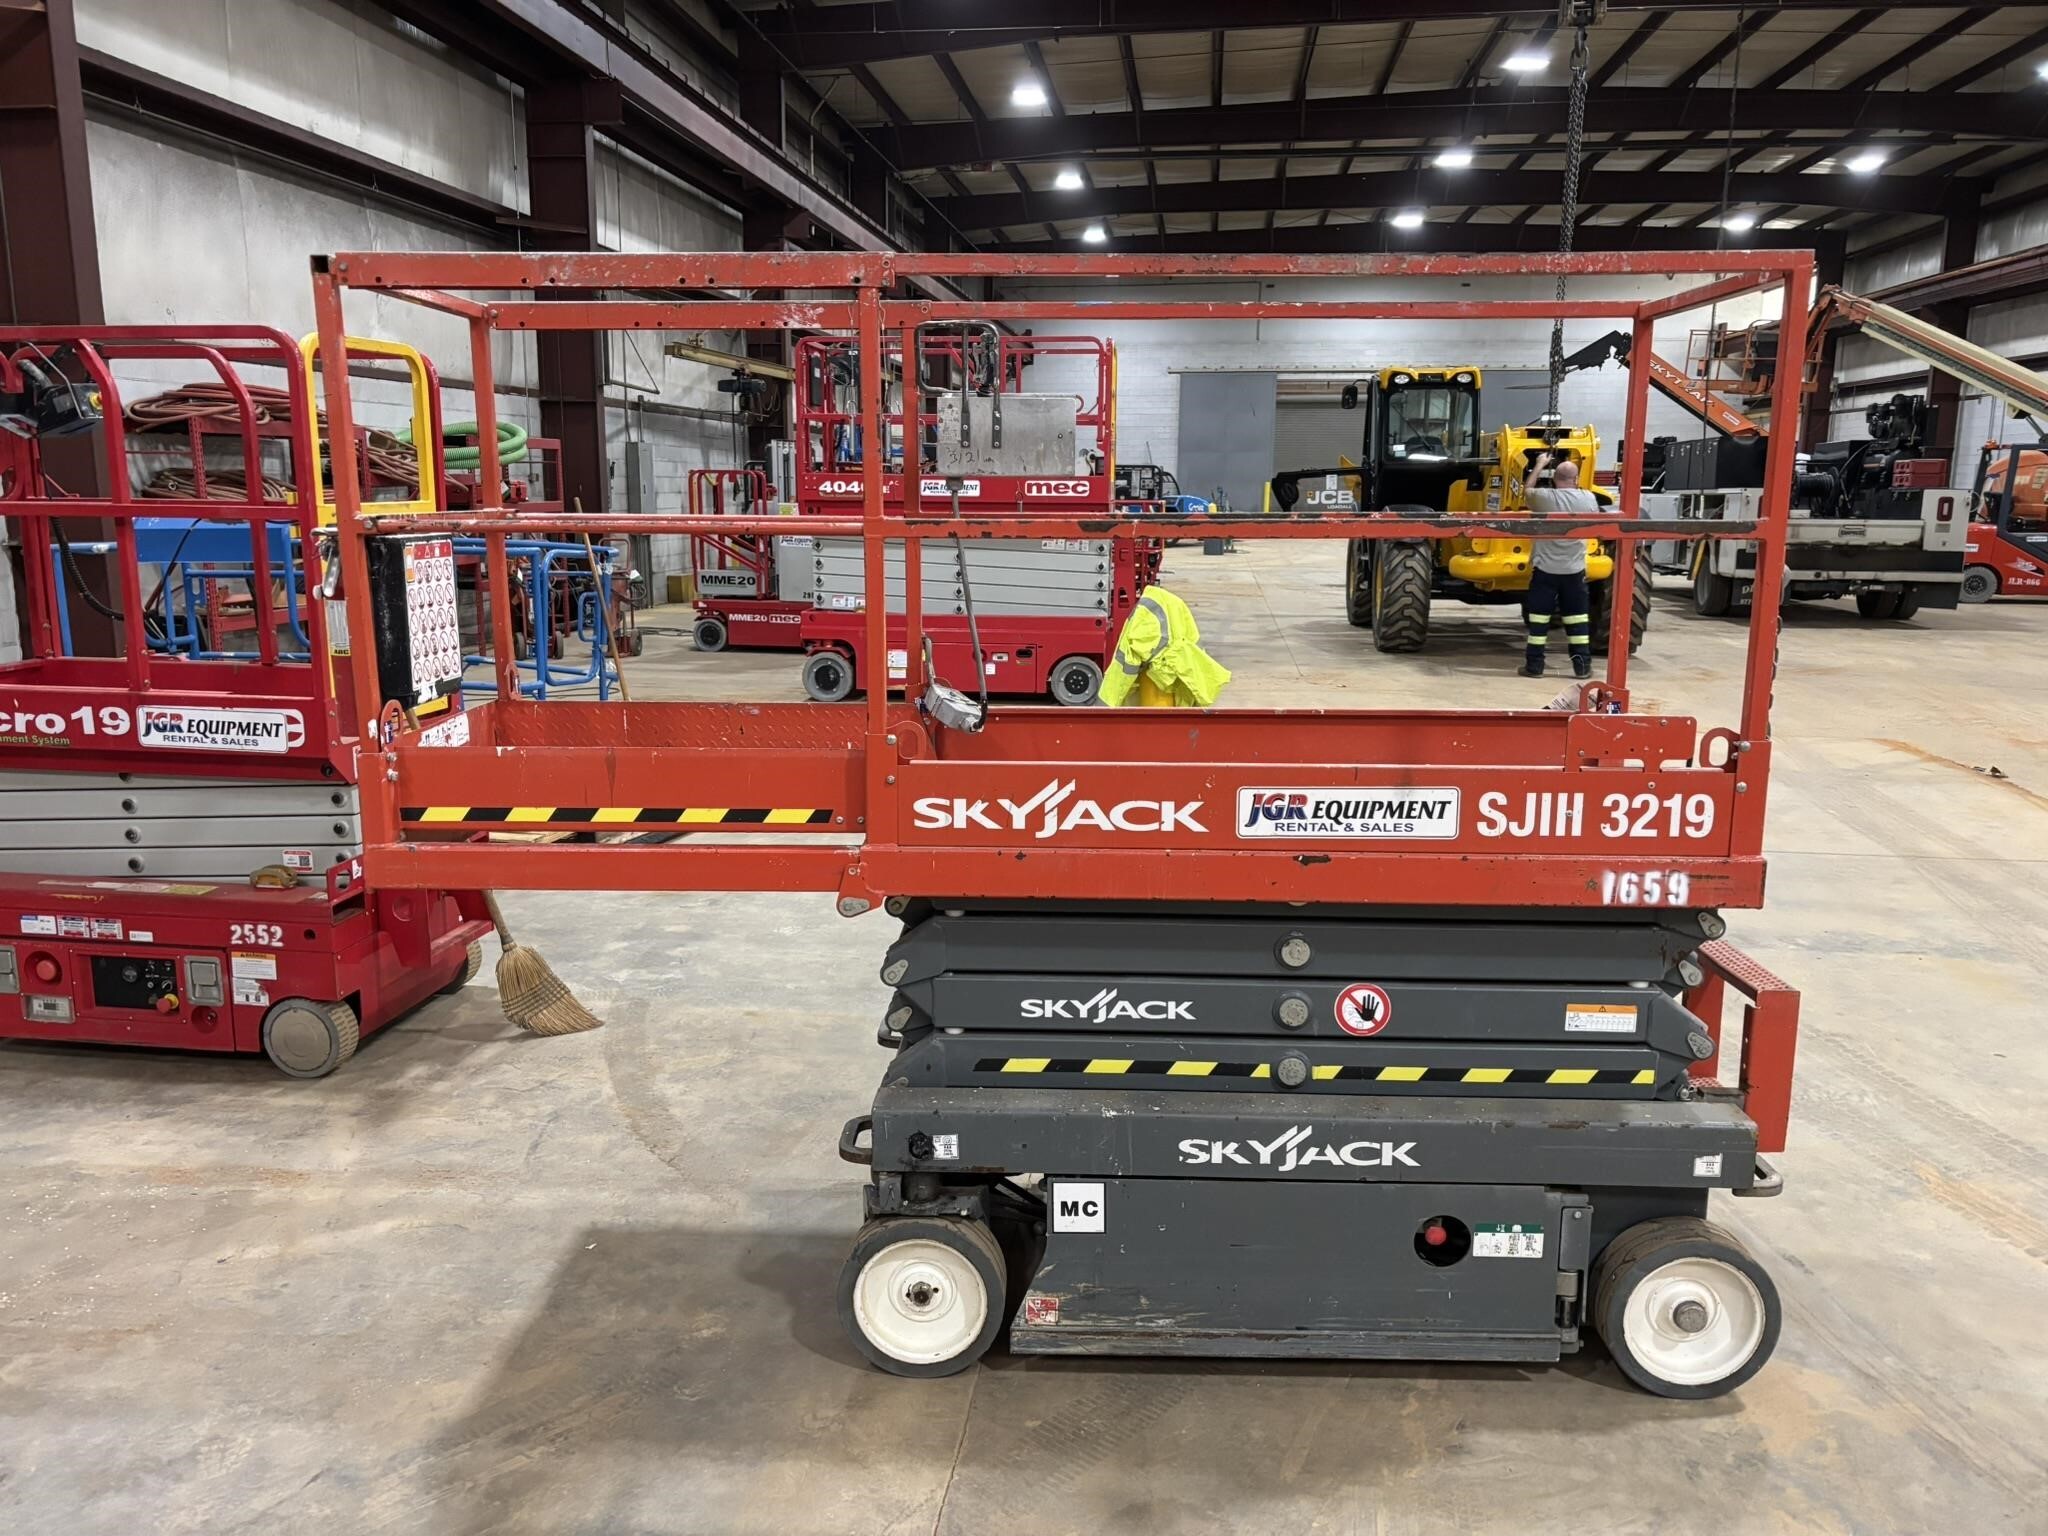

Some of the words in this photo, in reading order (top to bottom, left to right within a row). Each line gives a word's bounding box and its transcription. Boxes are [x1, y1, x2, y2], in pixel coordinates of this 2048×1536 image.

[1026, 482, 1088, 494] mec
[1307, 490, 1354, 505] JCB
[701, 575, 756, 586] MME20
[728, 613, 767, 622] MME20
[770, 615, 800, 623] mec
[142, 711, 184, 737] JGR
[187, 719, 283, 739] EQUIPMENT
[32, 735, 70, 746] System
[163, 734, 208, 744] RENTAL
[210, 736, 219, 744] &
[221, 737, 259, 747] SALES
[913, 778, 1210, 839] SKYJACK
[1244, 793, 1309, 827] JGR
[1311, 800, 1452, 825] EQUIPMENT
[1600, 793, 1715, 839] 3219
[1274, 822, 1339, 832] RENTAL
[1344, 822, 1355, 832] &
[1360, 822, 1414, 833] SALES
[1602, 868, 1690, 907] 1659
[230, 924, 284, 947] 2552
[1020, 987, 1197, 1024] SKYJACK
[1178, 1124, 1422, 1172] SKYJACK
[1060, 1200, 1099, 1217] MC
